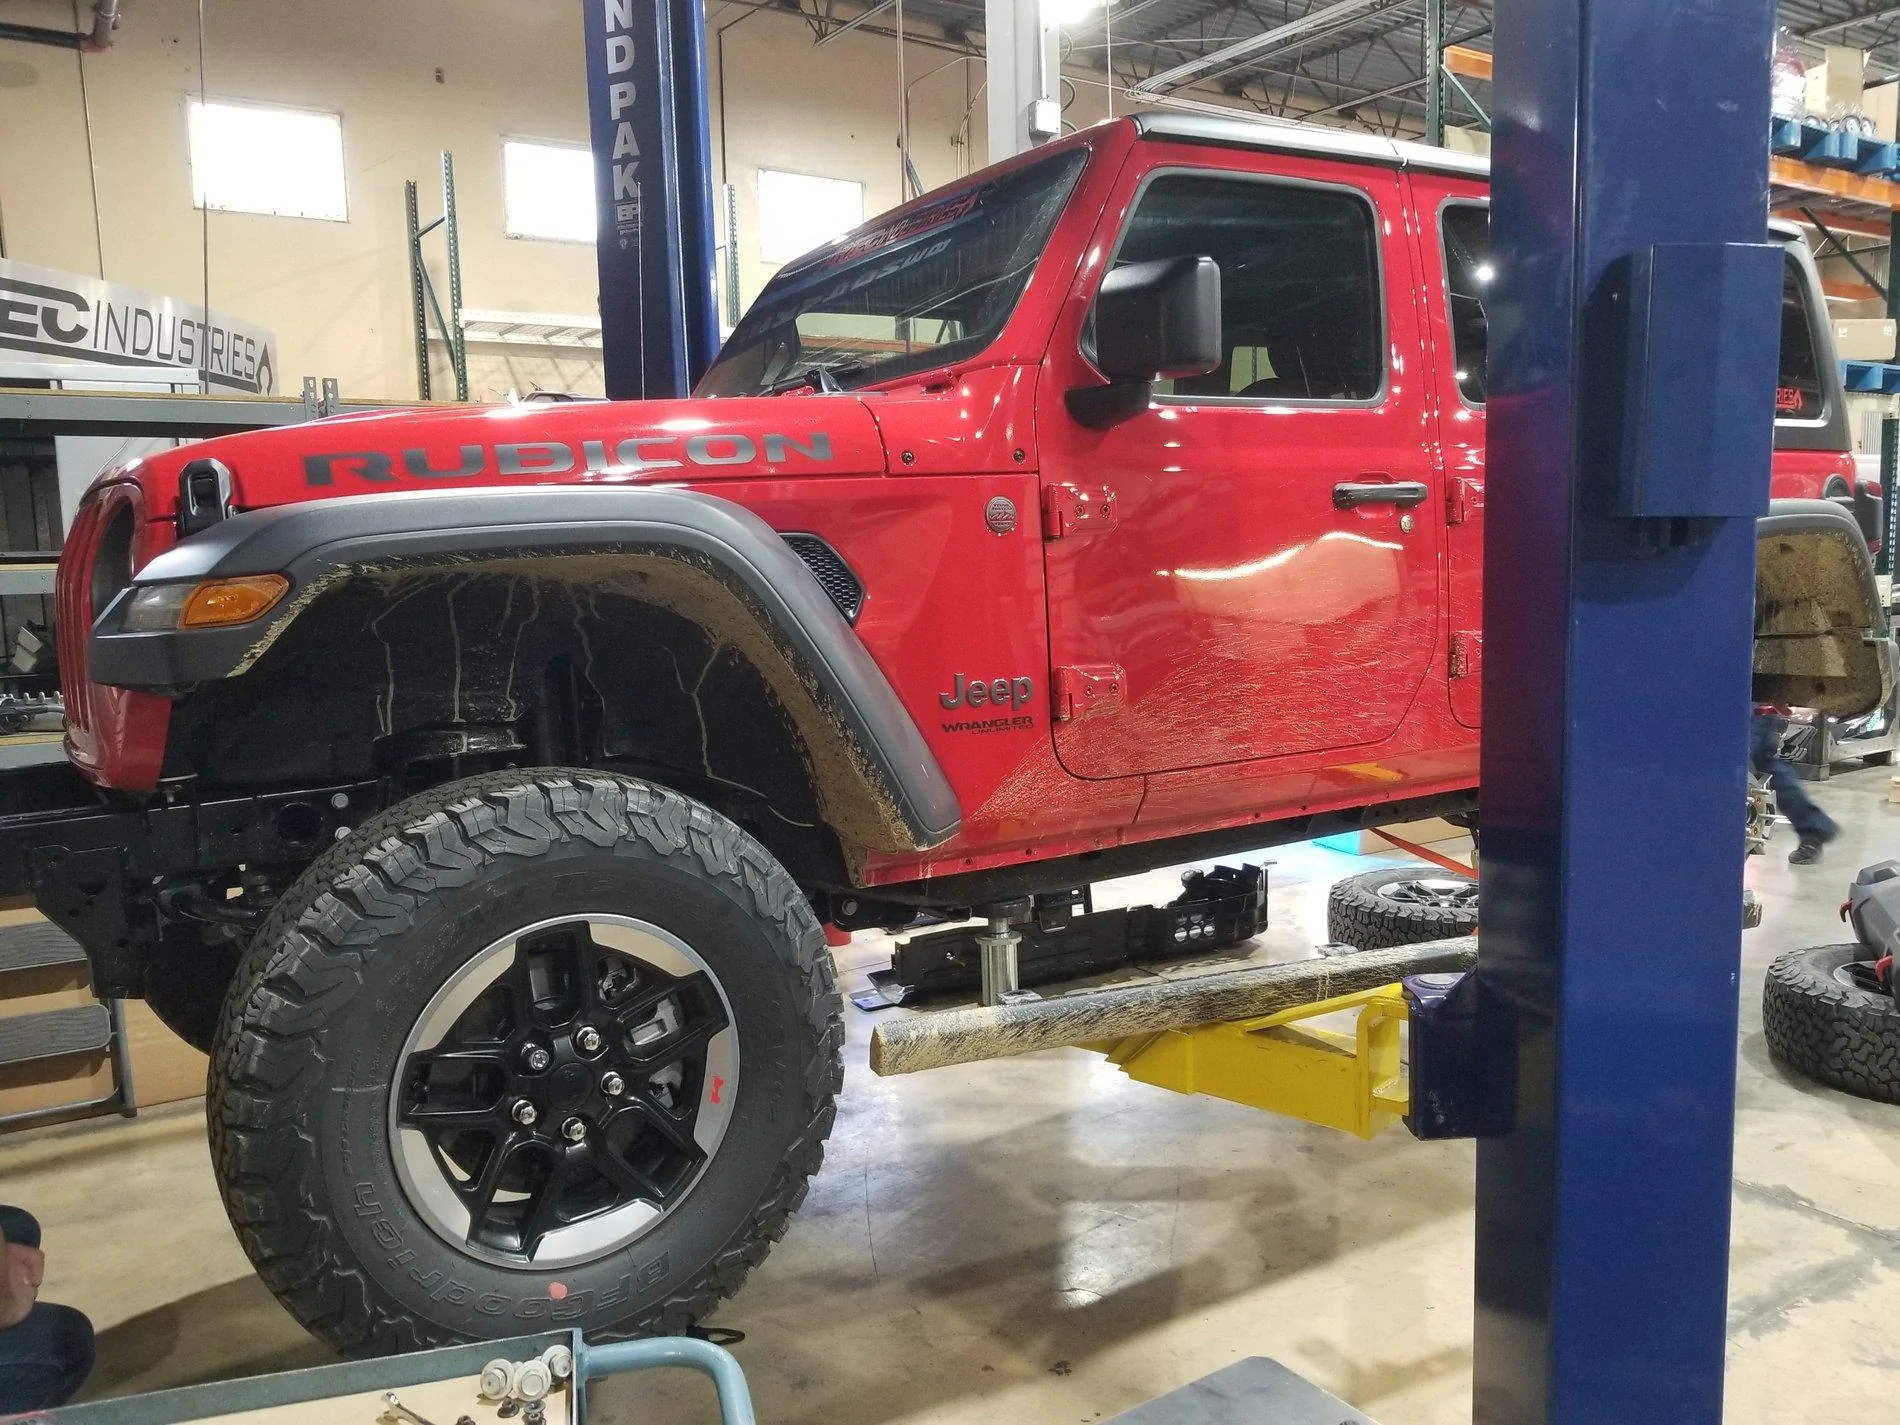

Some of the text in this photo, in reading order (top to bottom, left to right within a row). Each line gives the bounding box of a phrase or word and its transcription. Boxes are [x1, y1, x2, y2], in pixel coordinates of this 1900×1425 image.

[604, 0, 641, 200] NDPAK
[305, 433, 833, 486] RUBICON
[939, 672, 1033, 711] Jeep
[941, 716, 1033, 733] WRANGLER
